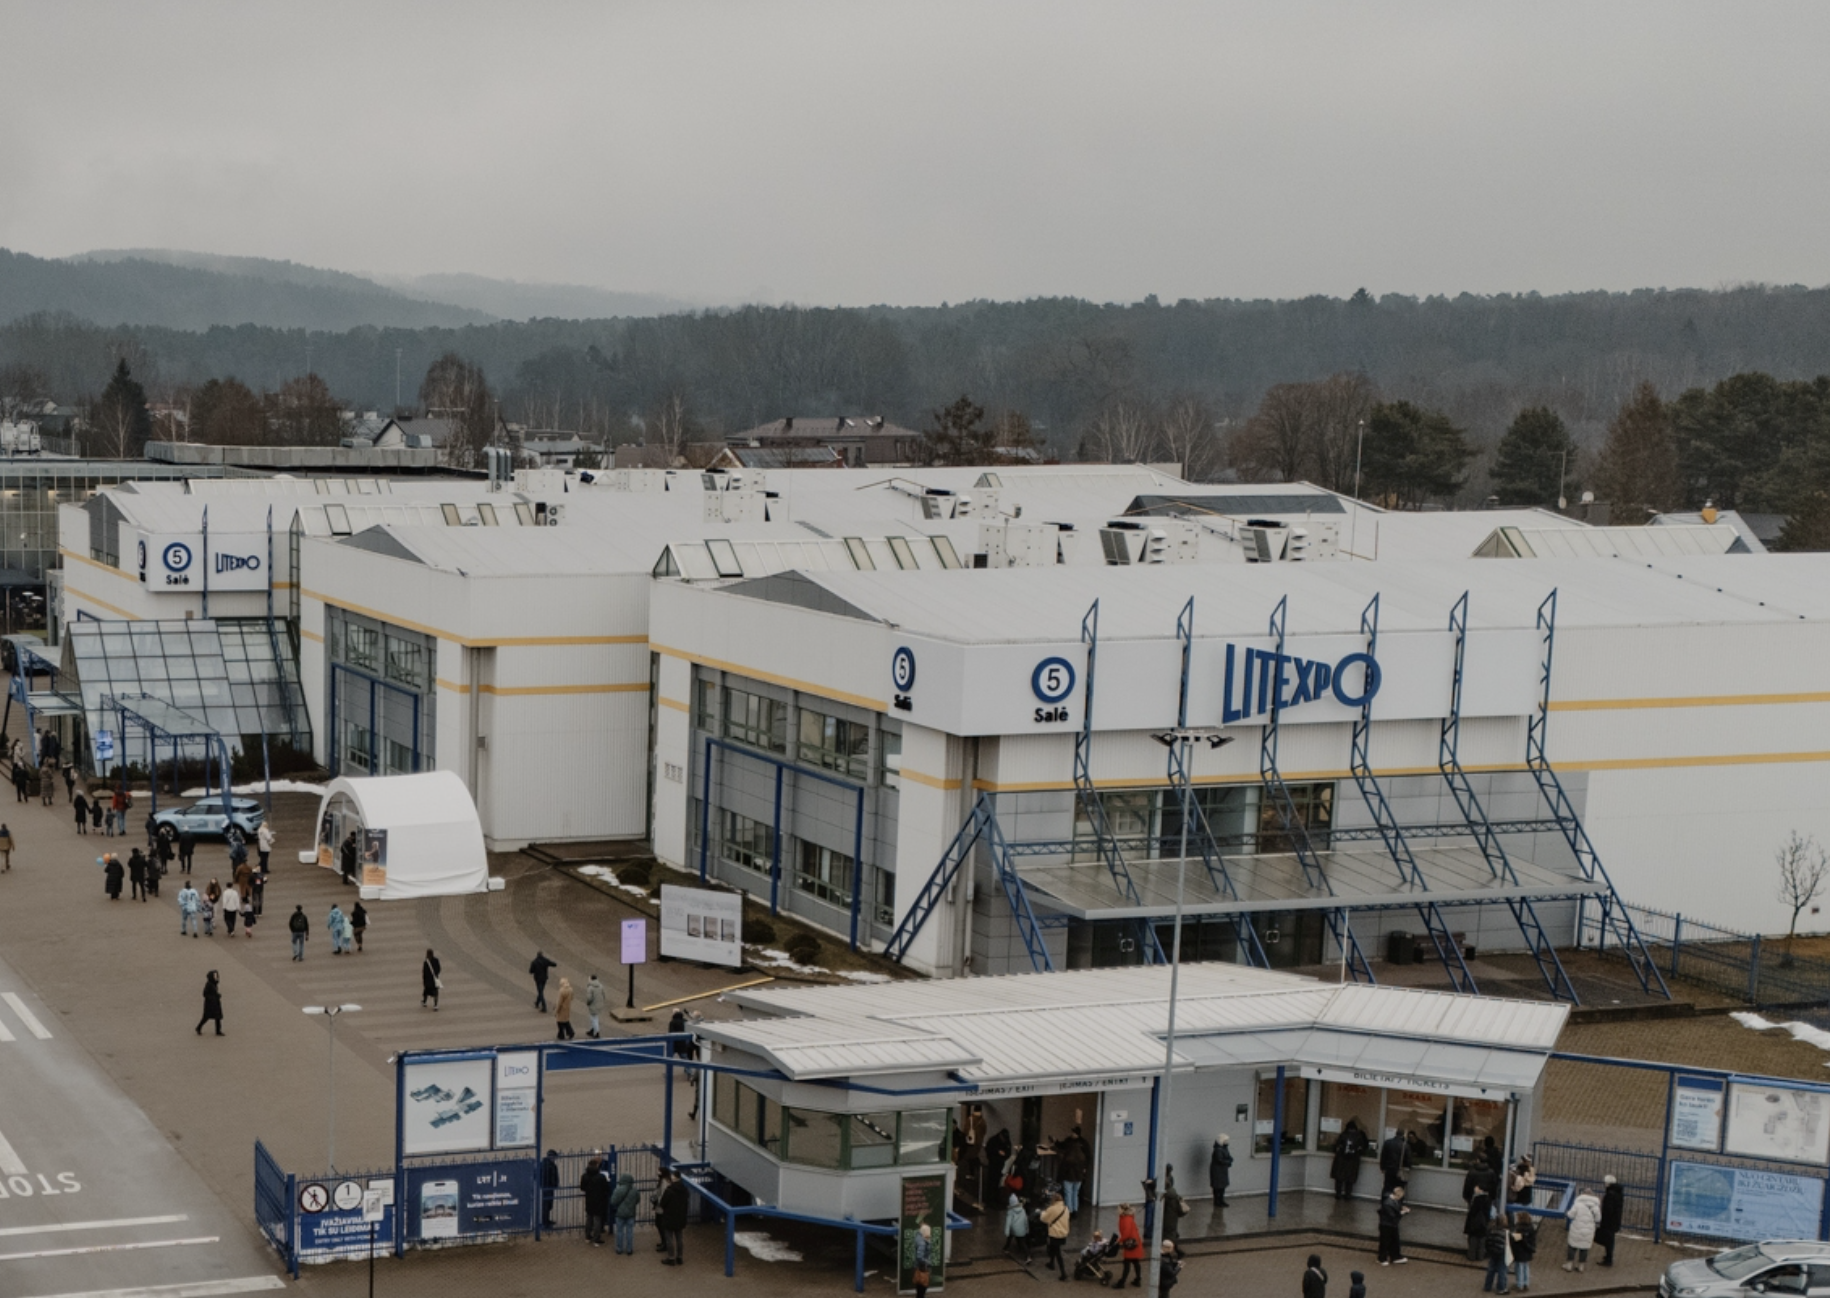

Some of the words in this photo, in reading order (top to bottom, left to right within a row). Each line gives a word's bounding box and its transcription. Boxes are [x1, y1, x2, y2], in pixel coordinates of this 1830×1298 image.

[172, 550, 183, 565] 5
[215, 551, 261, 574] LITEXPO
[166, 574, 190, 585] Salė
[1047, 669, 1060, 692] 5
[1221, 642, 1382, 725] LITEXPO
[1033, 705, 1069, 723] Salė
[344, 1183, 350, 1196] 1
[313, 1227, 326, 1236] TIK
[340, 1223, 381, 1234] LEIDIMAS
